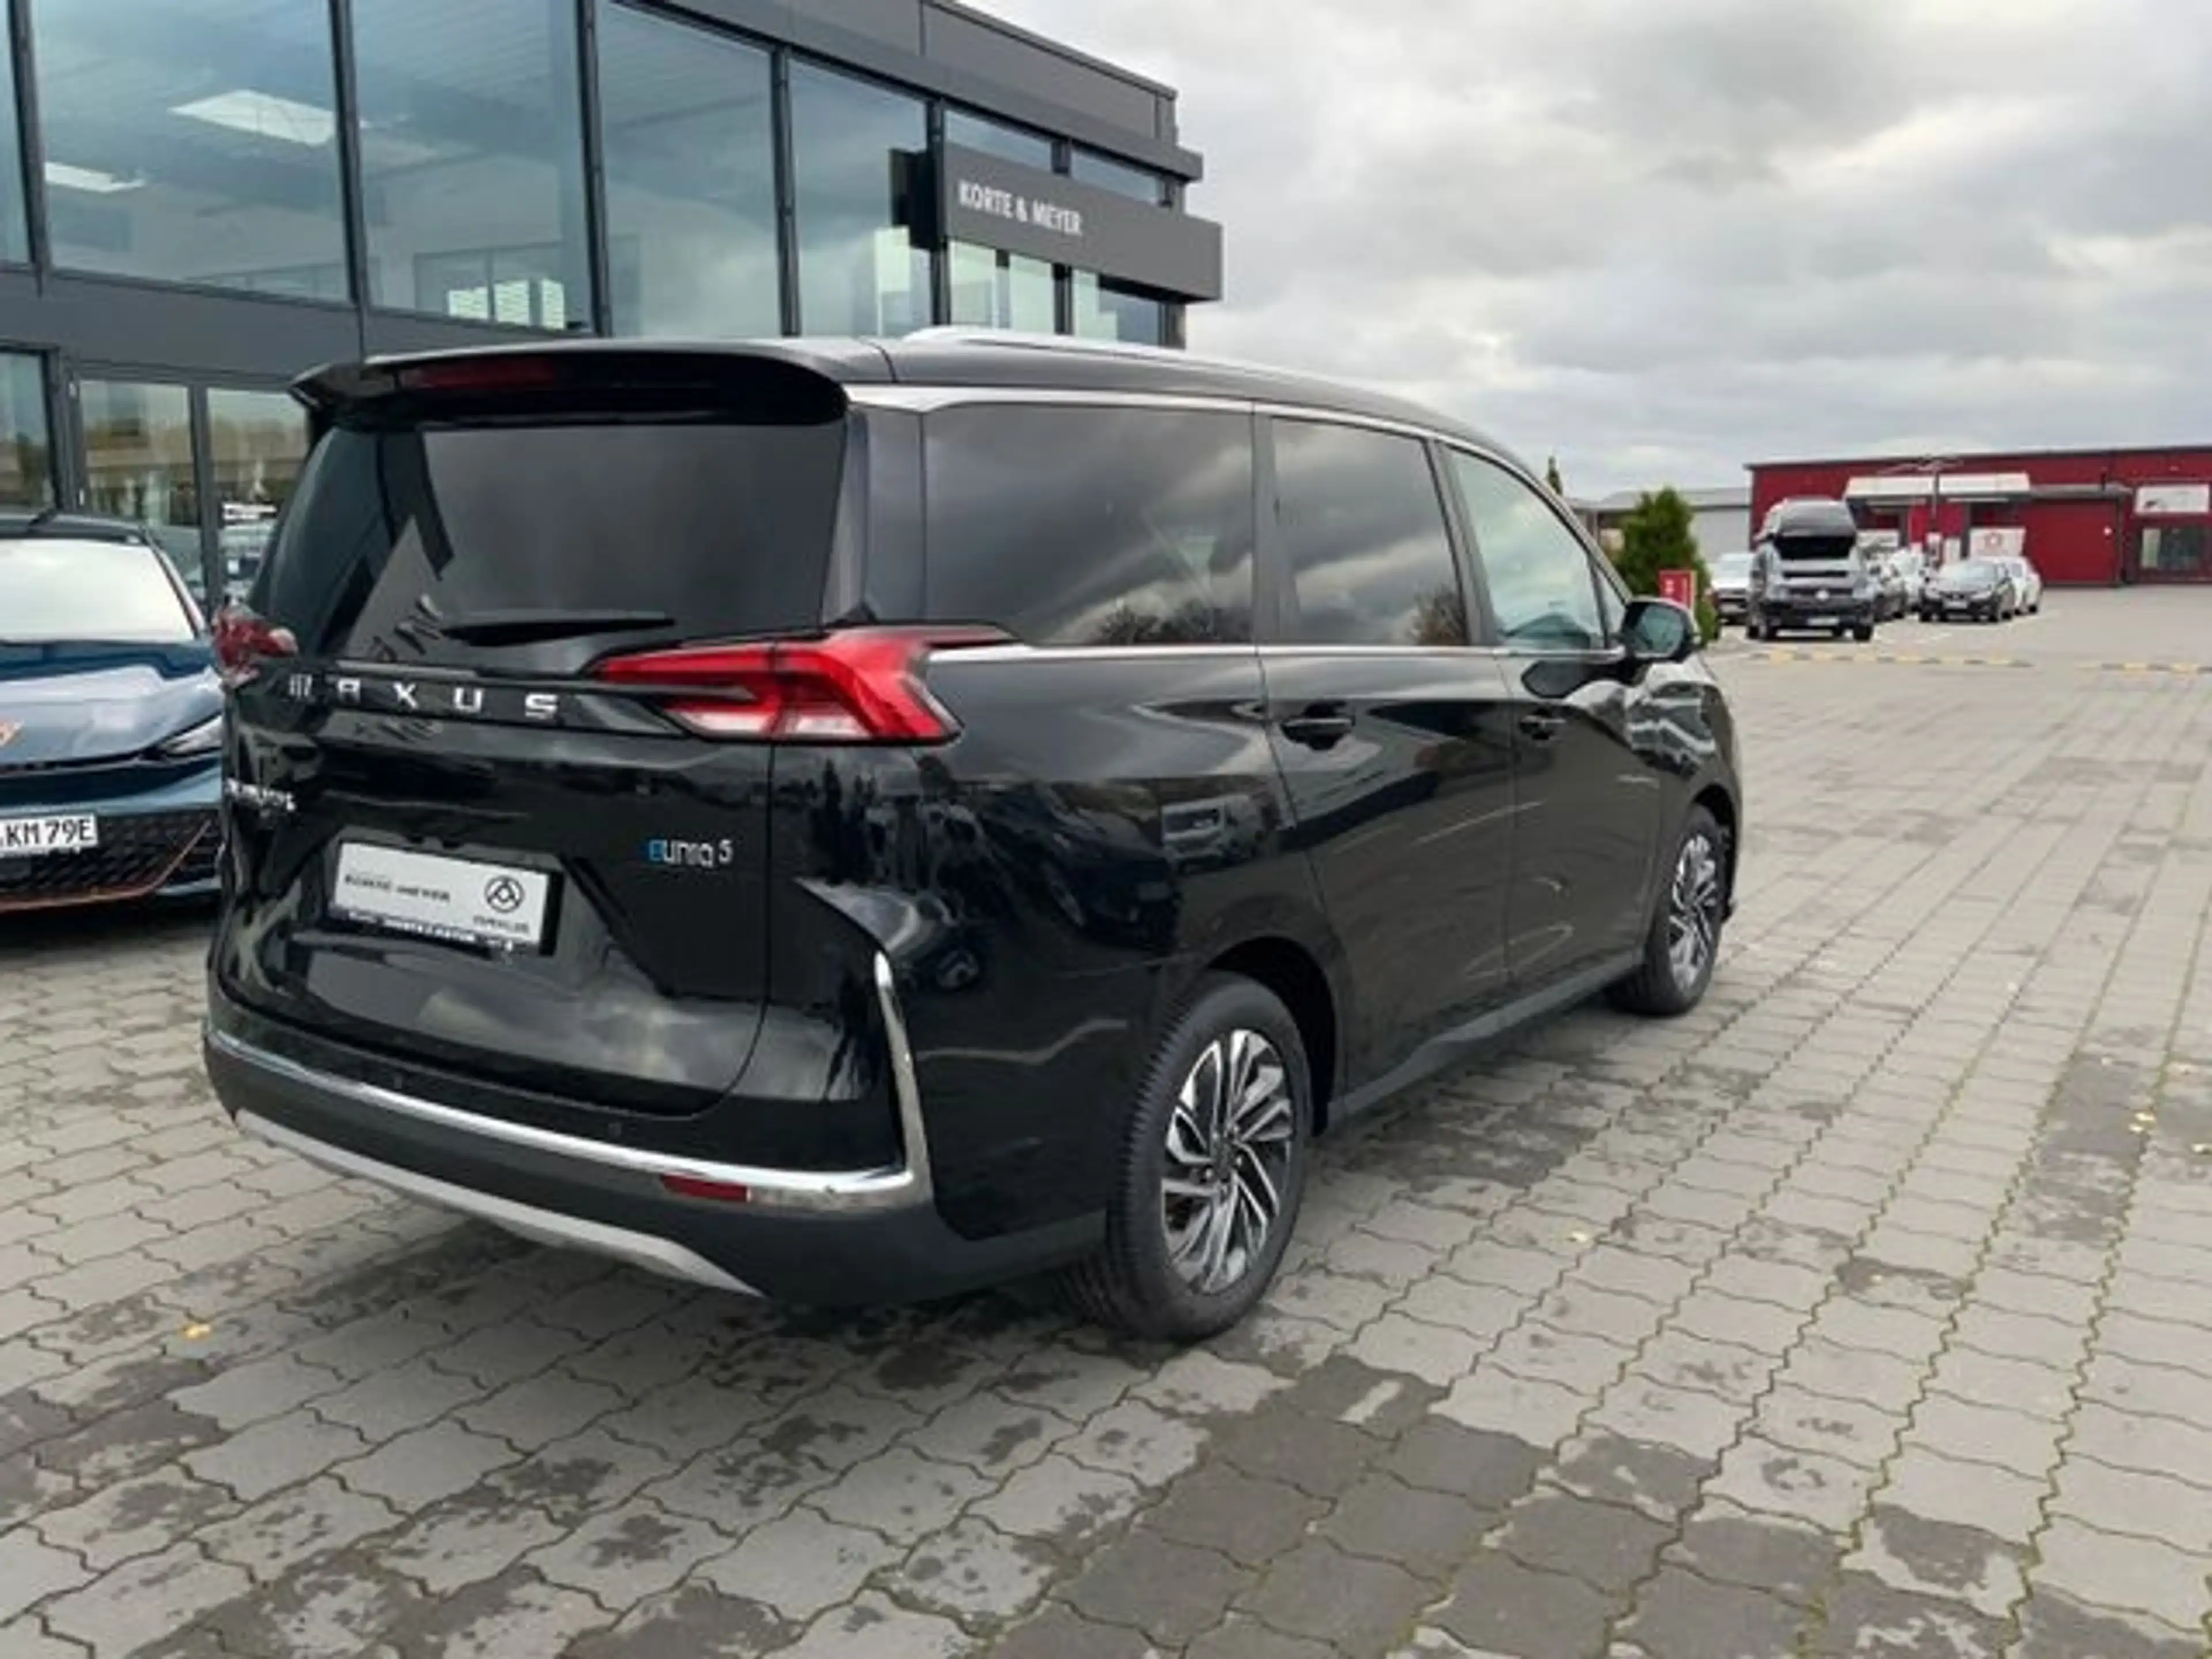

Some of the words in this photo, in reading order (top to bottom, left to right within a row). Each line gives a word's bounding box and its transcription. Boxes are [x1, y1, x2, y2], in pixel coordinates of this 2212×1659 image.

[959, 180, 1013, 219] KORTE
[1016, 196, 1028, 223] &
[1033, 199, 1084, 236] MEYER
